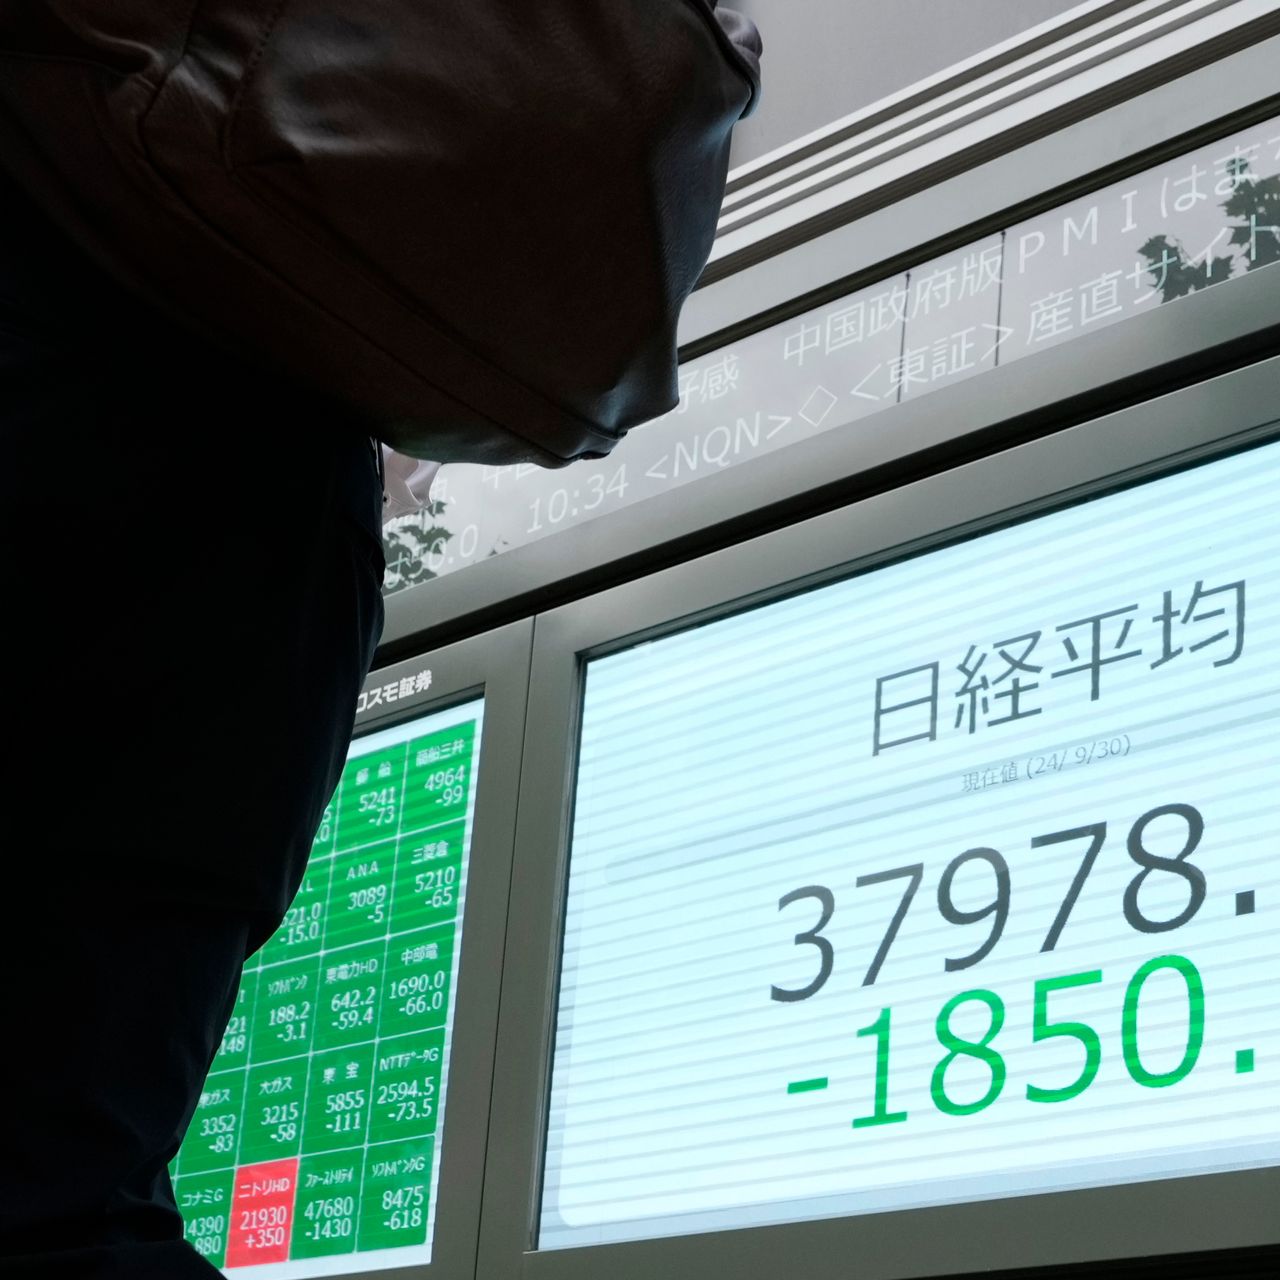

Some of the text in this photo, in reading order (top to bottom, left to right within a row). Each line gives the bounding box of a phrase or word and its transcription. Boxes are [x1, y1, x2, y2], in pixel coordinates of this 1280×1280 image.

[526, 463, 630, 534] 10:34
[872, 578, 1248, 757] 日経平均
[425, 765, 465, 791] 4964
[962, 762, 1018, 792] 現在値
[358, 787, 395, 811] 5241
[436, 787, 463, 806] -99
[369, 806, 394, 826] -73
[415, 867, 455, 893] 5210
[348, 885, 386, 910] 3089
[425, 887, 452, 908] -65
[368, 905, 384, 923] -5
[280, 922, 319, 945] -15.0
[389, 971, 445, 999] 1690.0
[331, 987, 376, 1012] 642.2
[399, 992, 442, 1016] -66.0
[268, 1001, 310, 1026] 188.2
[332, 1007, 374, 1031] -59.4
[277, 1022, 307, 1042] -3.1
[259, 1076, 292, 1095] 大ガス
[377, 1076, 435, 1105] 2594.5
[261, 1102, 299, 1126] 3215
[326, 1090, 365, 1114] 5855
[388, 1098, 432, 1122] -73.5
[200, 1114, 236, 1137] 3352
[270, 1123, 296, 1142] -58
[326, 1112, 361, 1133] -111
[208, 1134, 233, 1153] -83
[181, 1188, 224, 1207] コナミG
[238, 1178, 290, 1199] ニトリHD
[382, 1185, 424, 1211] 8475
[240, 1205, 288, 1231] 21930
[304, 1197, 354, 1221] 47680
[383, 1208, 422, 1231] -618
[245, 1227, 285, 1249] +350
[305, 1218, 352, 1240] -1430
